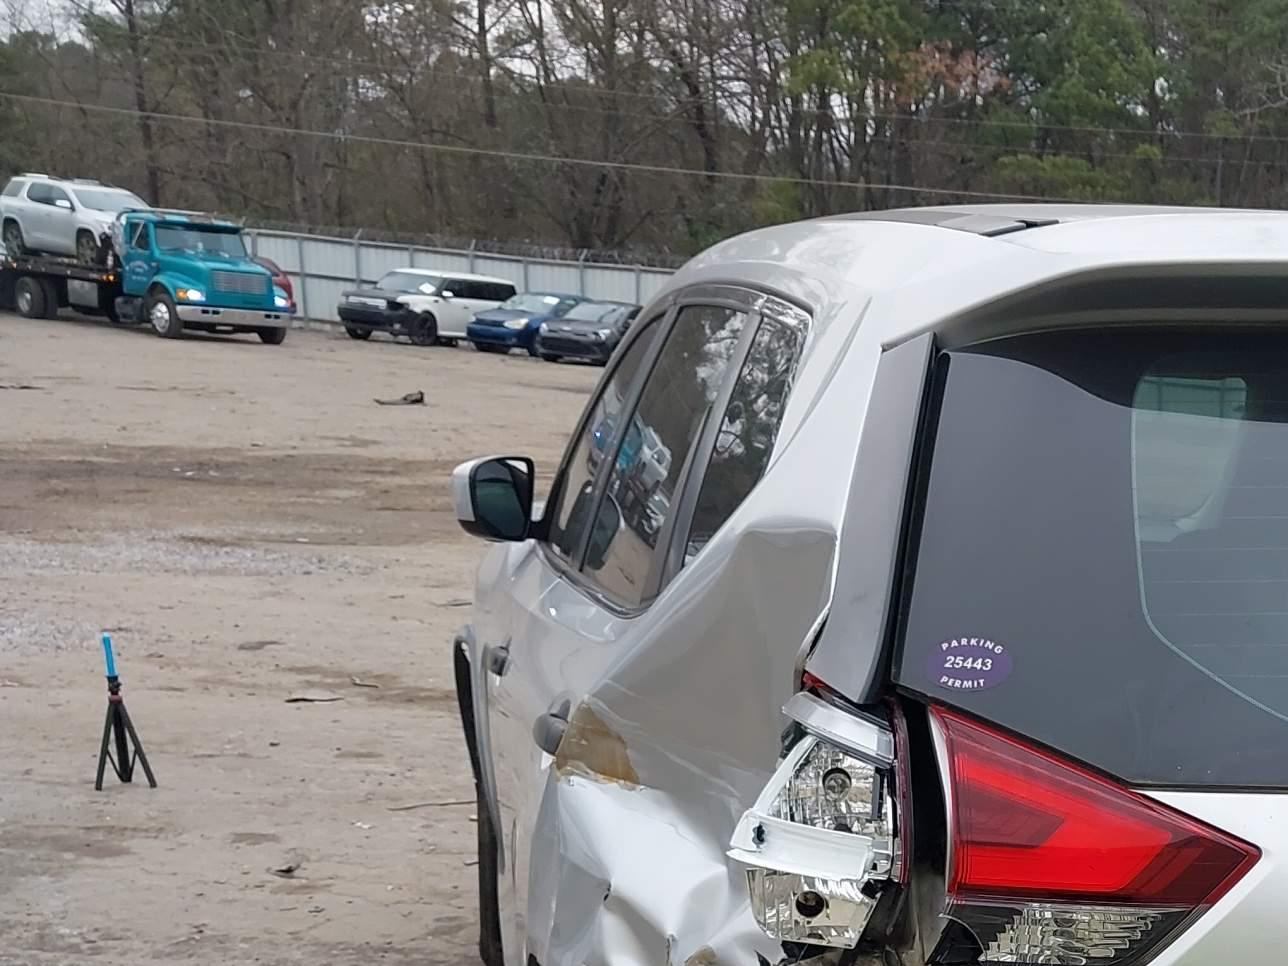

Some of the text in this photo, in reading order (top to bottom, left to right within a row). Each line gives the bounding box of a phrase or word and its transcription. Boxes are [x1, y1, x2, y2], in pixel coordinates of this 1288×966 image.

[940, 637, 1005, 655] PARKING
[943, 655, 993, 671] 25443
[939, 675, 986, 689] PERMIT
